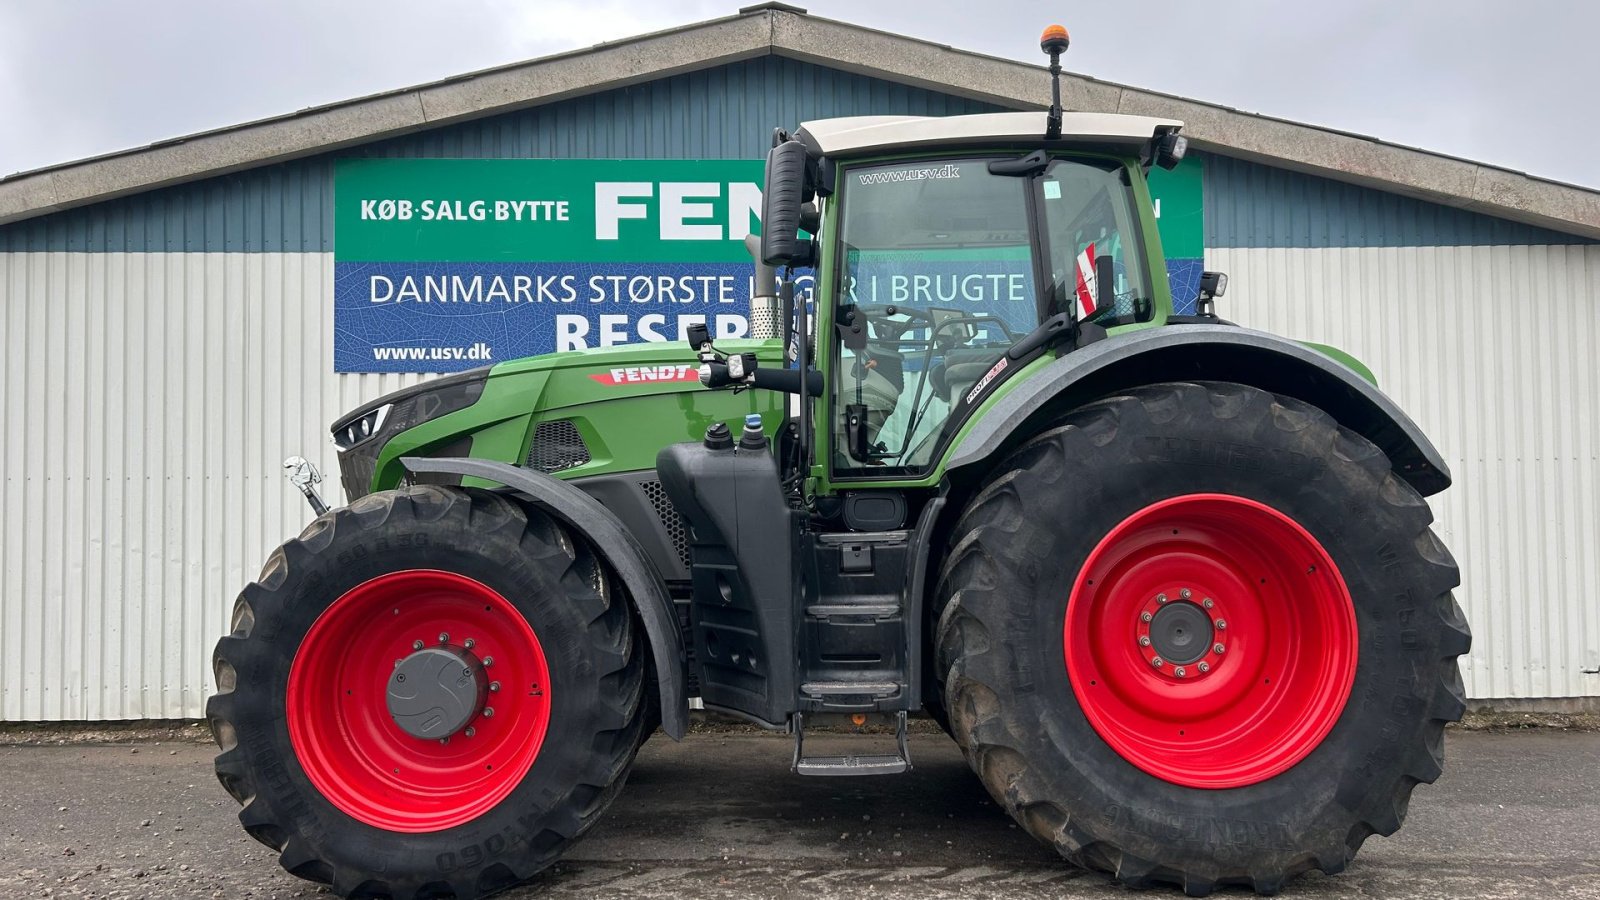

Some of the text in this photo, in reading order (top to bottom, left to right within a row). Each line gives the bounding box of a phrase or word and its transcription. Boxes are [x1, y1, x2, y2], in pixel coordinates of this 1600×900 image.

[859, 165, 960, 185] www.usv.dk
[370, 275, 577, 303] DANMARKS
[588, 275, 735, 304] STØRSTE
[871, 275, 877, 302] I
[891, 274, 1025, 302] BRUGTE
[373, 343, 492, 360] www.usv.dk
[609, 364, 692, 383] FENDT
